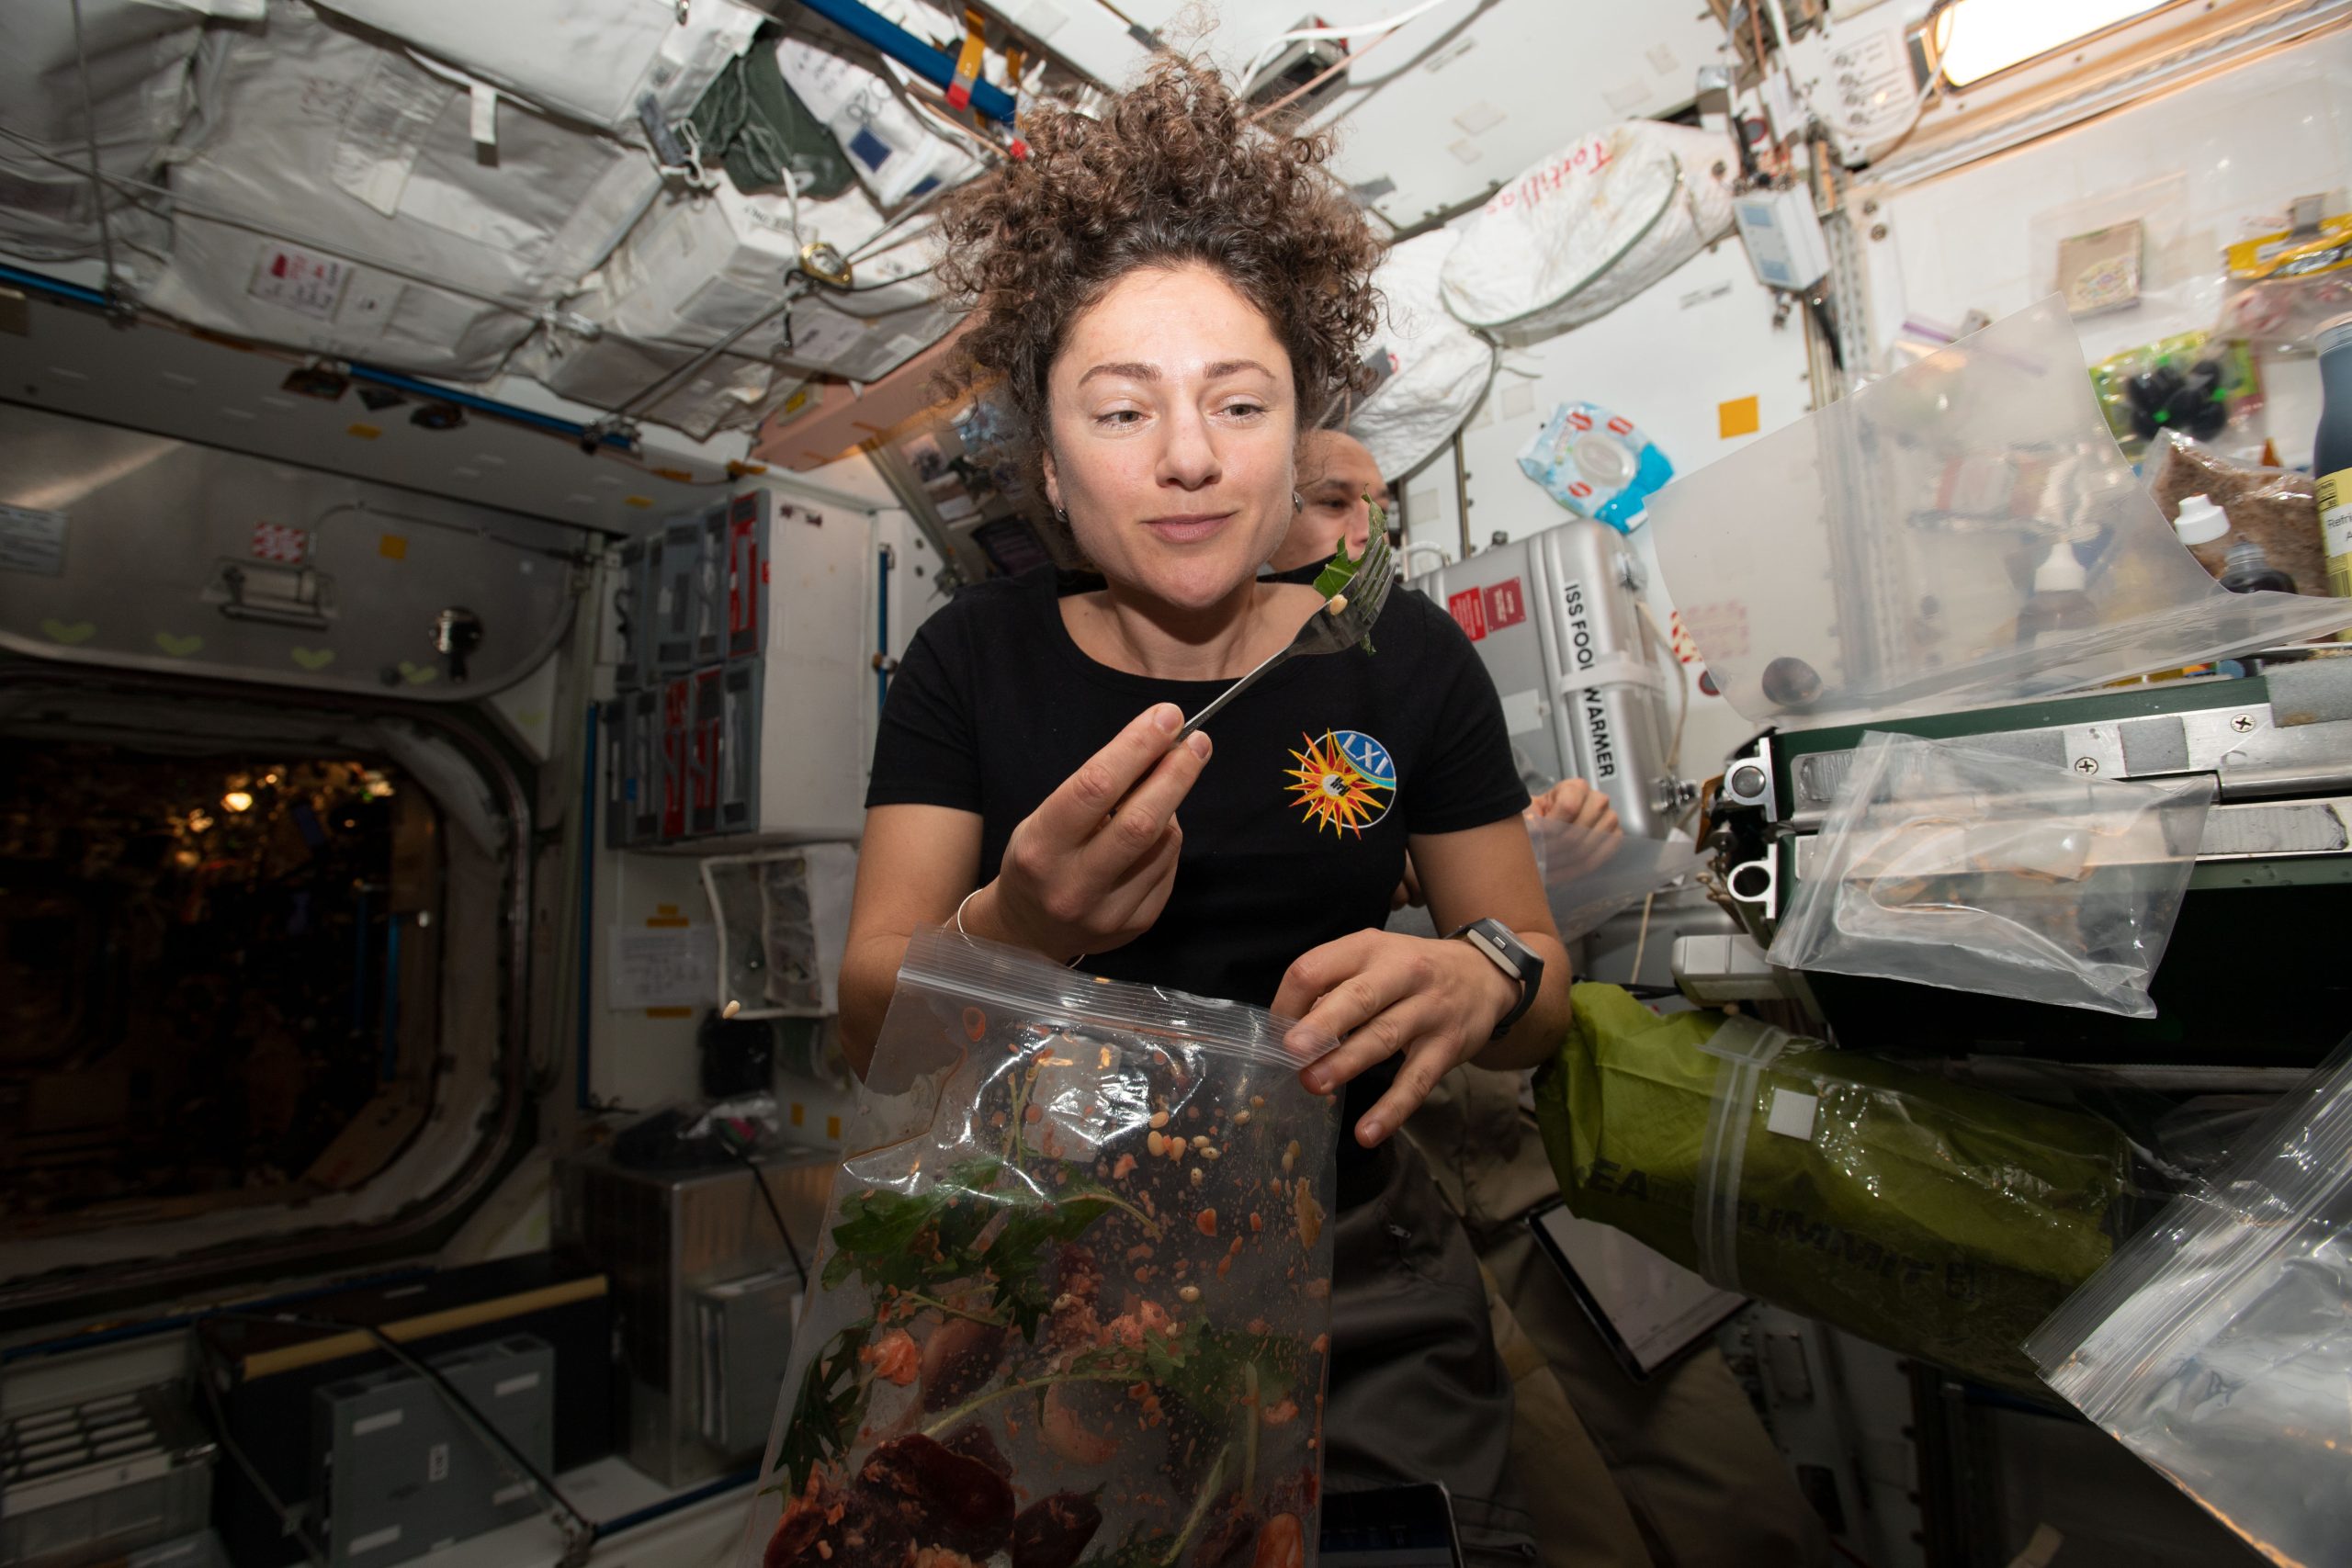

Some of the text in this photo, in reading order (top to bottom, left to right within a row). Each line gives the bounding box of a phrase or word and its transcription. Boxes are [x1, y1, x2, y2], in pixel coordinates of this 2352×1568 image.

[1566, 584, 1615, 778] ISS FOO WARMER
[1342, 733, 1390, 776] LXI
[1578, 1157, 1649, 1202] EA
